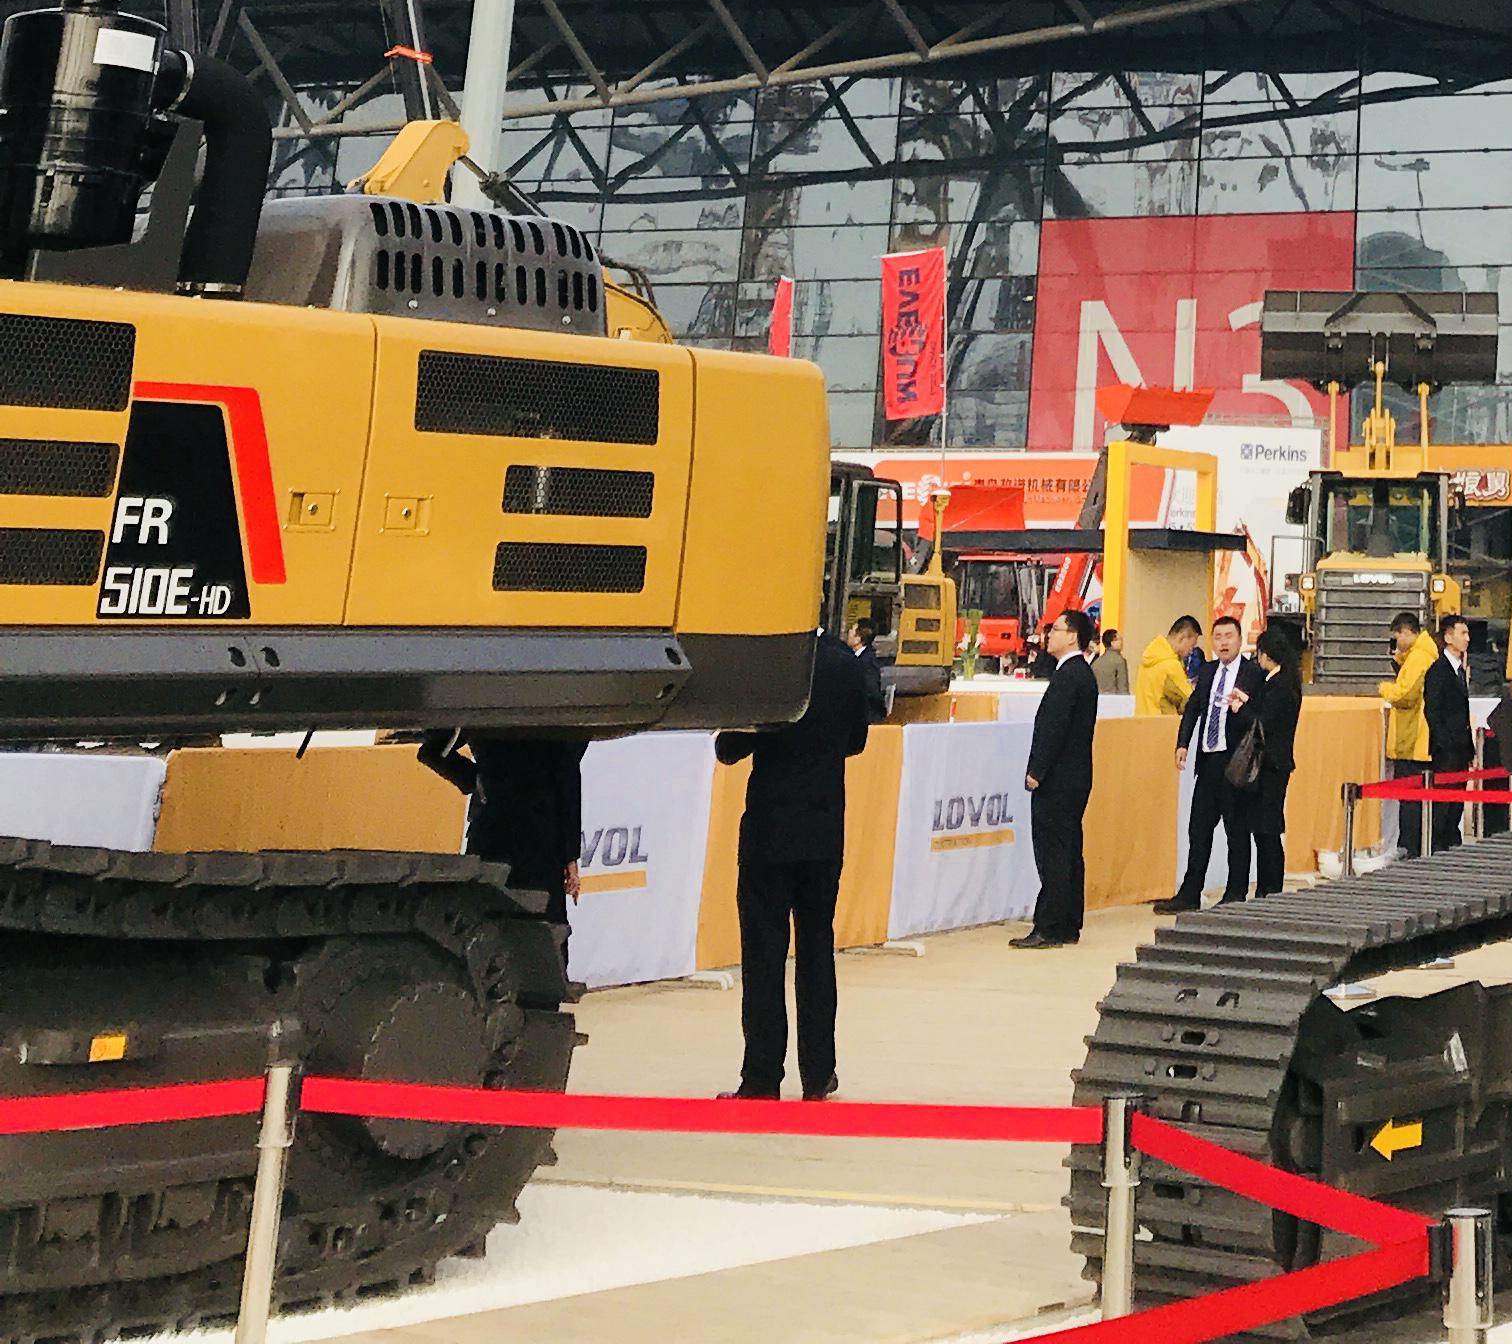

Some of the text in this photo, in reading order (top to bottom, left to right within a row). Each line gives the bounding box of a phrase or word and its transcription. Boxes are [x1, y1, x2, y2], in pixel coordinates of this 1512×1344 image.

[1255, 444, 1308, 462] Perkins
[112, 496, 173, 545] FR
[100, 566, 232, 615] 510E-HD
[932, 792, 1014, 831] LOVOL
[580, 825, 648, 868] VOL
